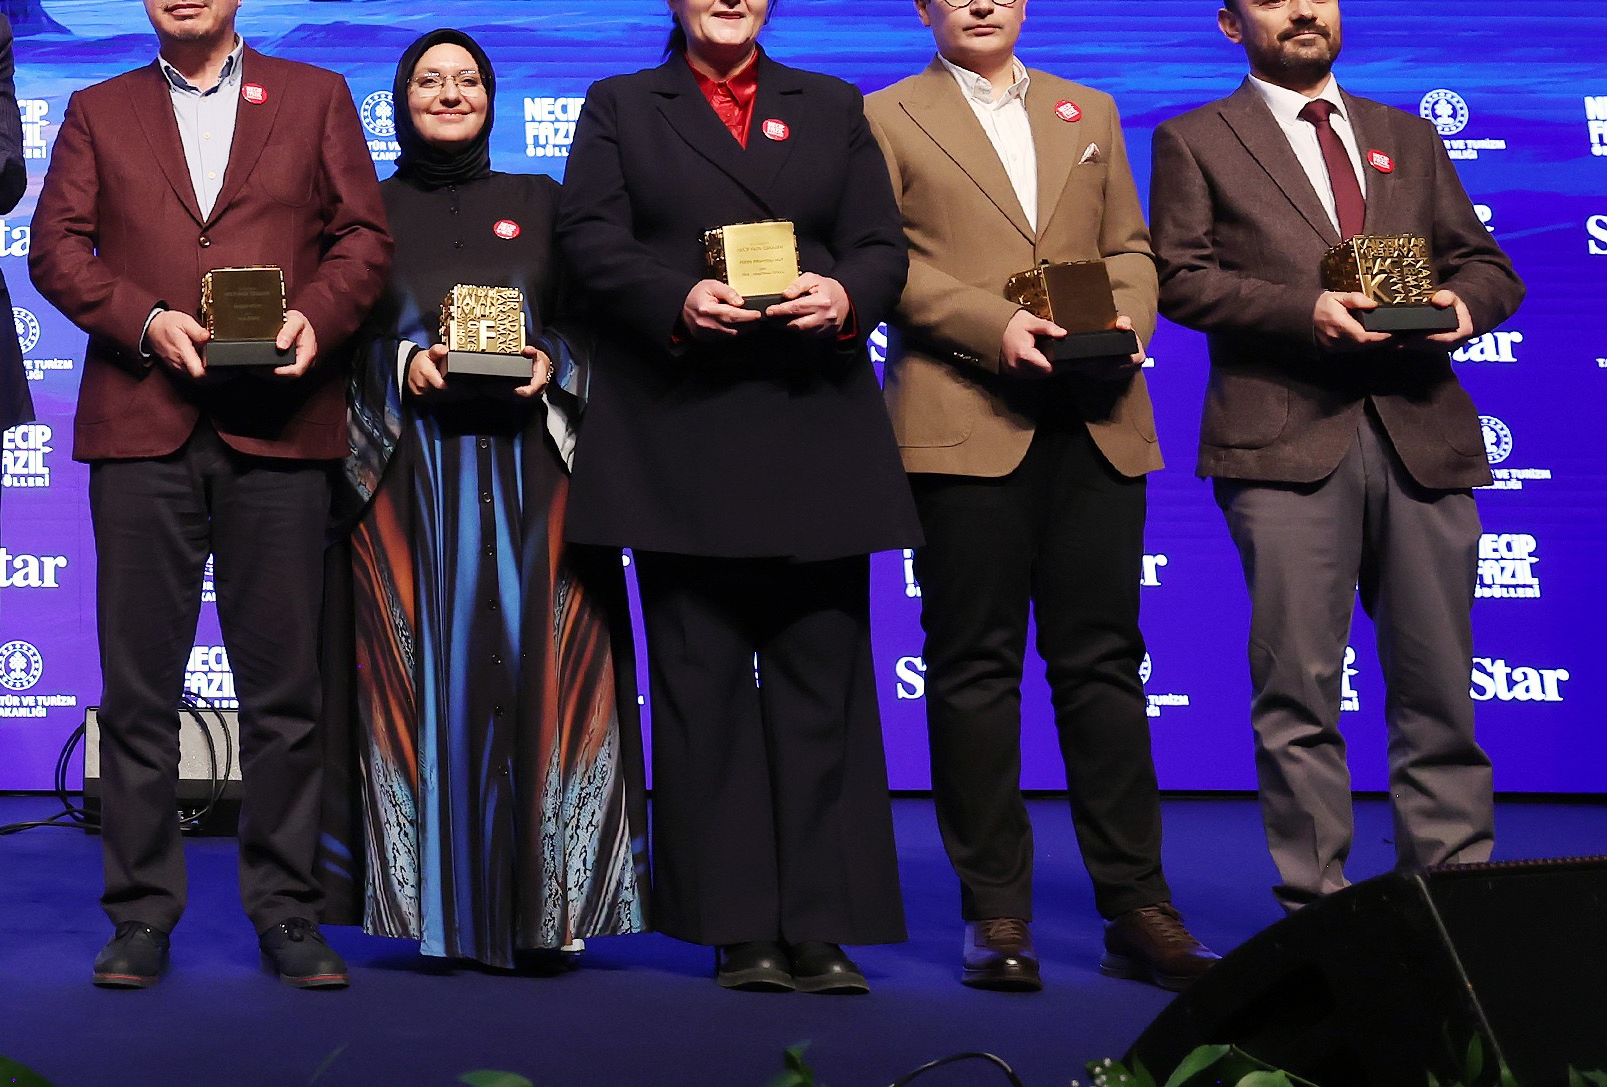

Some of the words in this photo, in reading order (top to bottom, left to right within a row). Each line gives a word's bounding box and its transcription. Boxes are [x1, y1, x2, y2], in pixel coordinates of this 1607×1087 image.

[525, 122, 577, 144] FAZI
[34, 358, 73, 369] TURİZM
[3, 425, 52, 449] ECİP
[2, 450, 50, 474] AZIL
[1, 474, 50, 487] ÜLLERİ
[1510, 468, 1551, 479] TURİZM
[0, 547, 68, 587] tar
[1469, 657, 1570, 701] Star
[21, 696, 35, 706] VE
[36, 694, 76, 706] TURİZM
[1147, 693, 1189, 705] TURİZM
